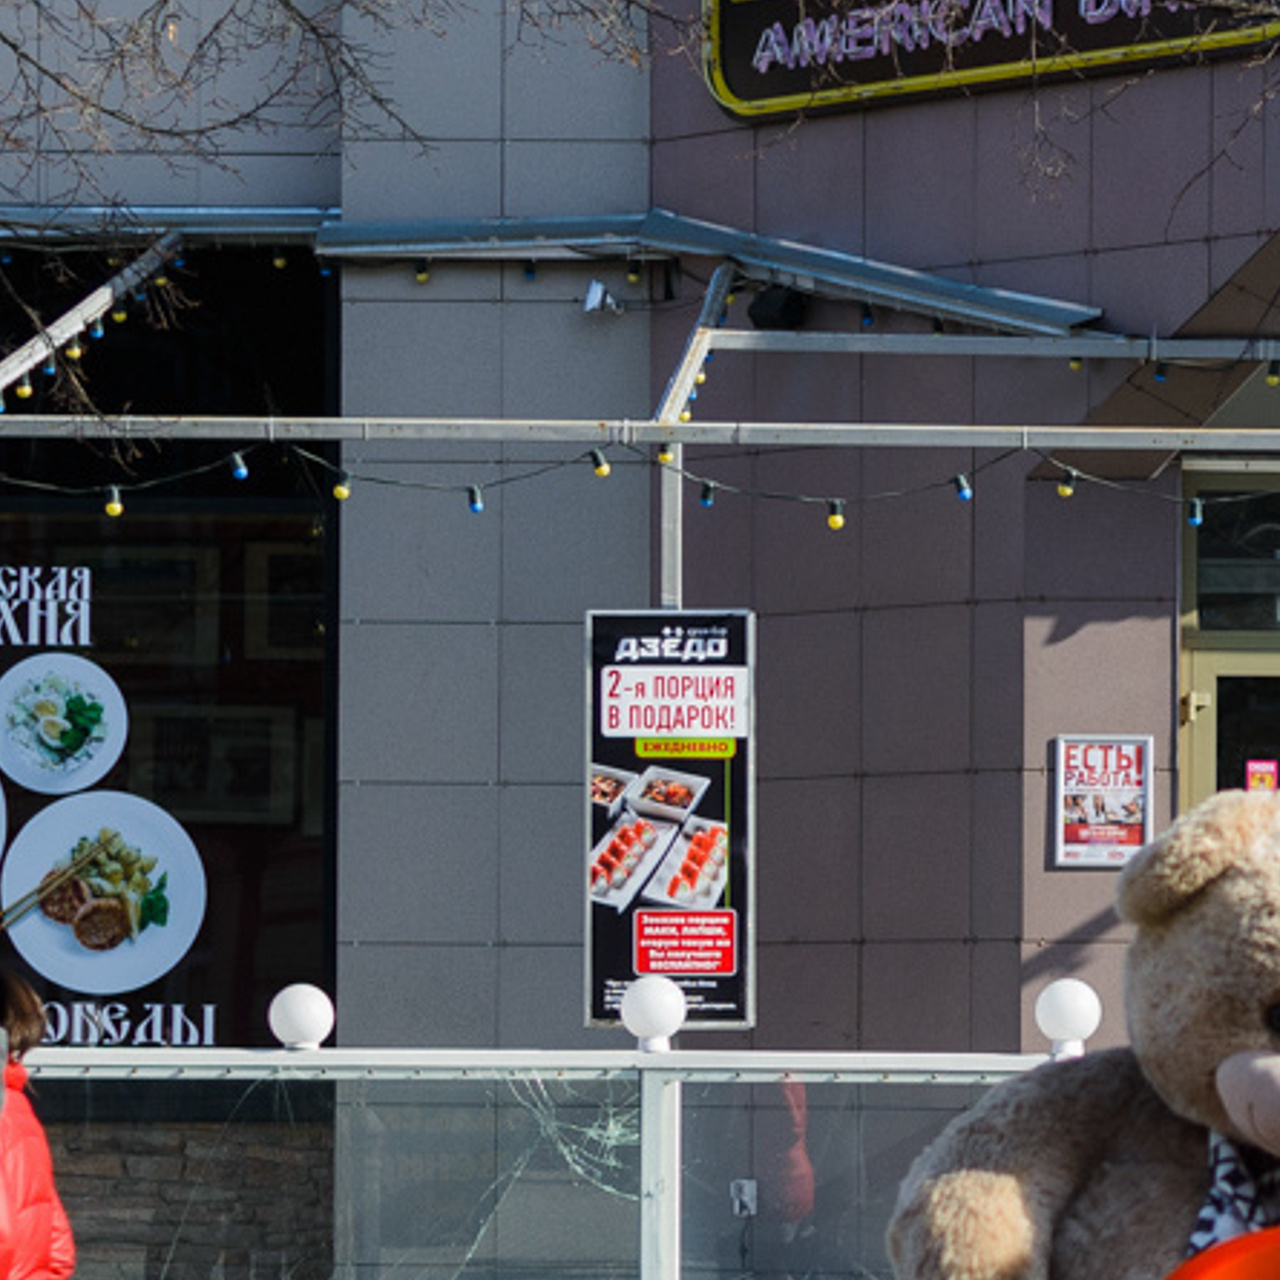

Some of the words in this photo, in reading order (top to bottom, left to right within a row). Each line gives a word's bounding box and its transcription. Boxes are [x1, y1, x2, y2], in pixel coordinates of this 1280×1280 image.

[614, 626, 728, 662] ДЗЁДО
[607, 669, 645, 698] 2-я
[653, 675, 735, 703] ПОРЦИЯ
[609, 704, 620, 730] В
[628, 704, 735, 733] ПОДАРОК!
[643, 741, 729, 754] ЕЖЕДНЕВНО
[1064, 744, 1133, 771] ЕСТЬ
